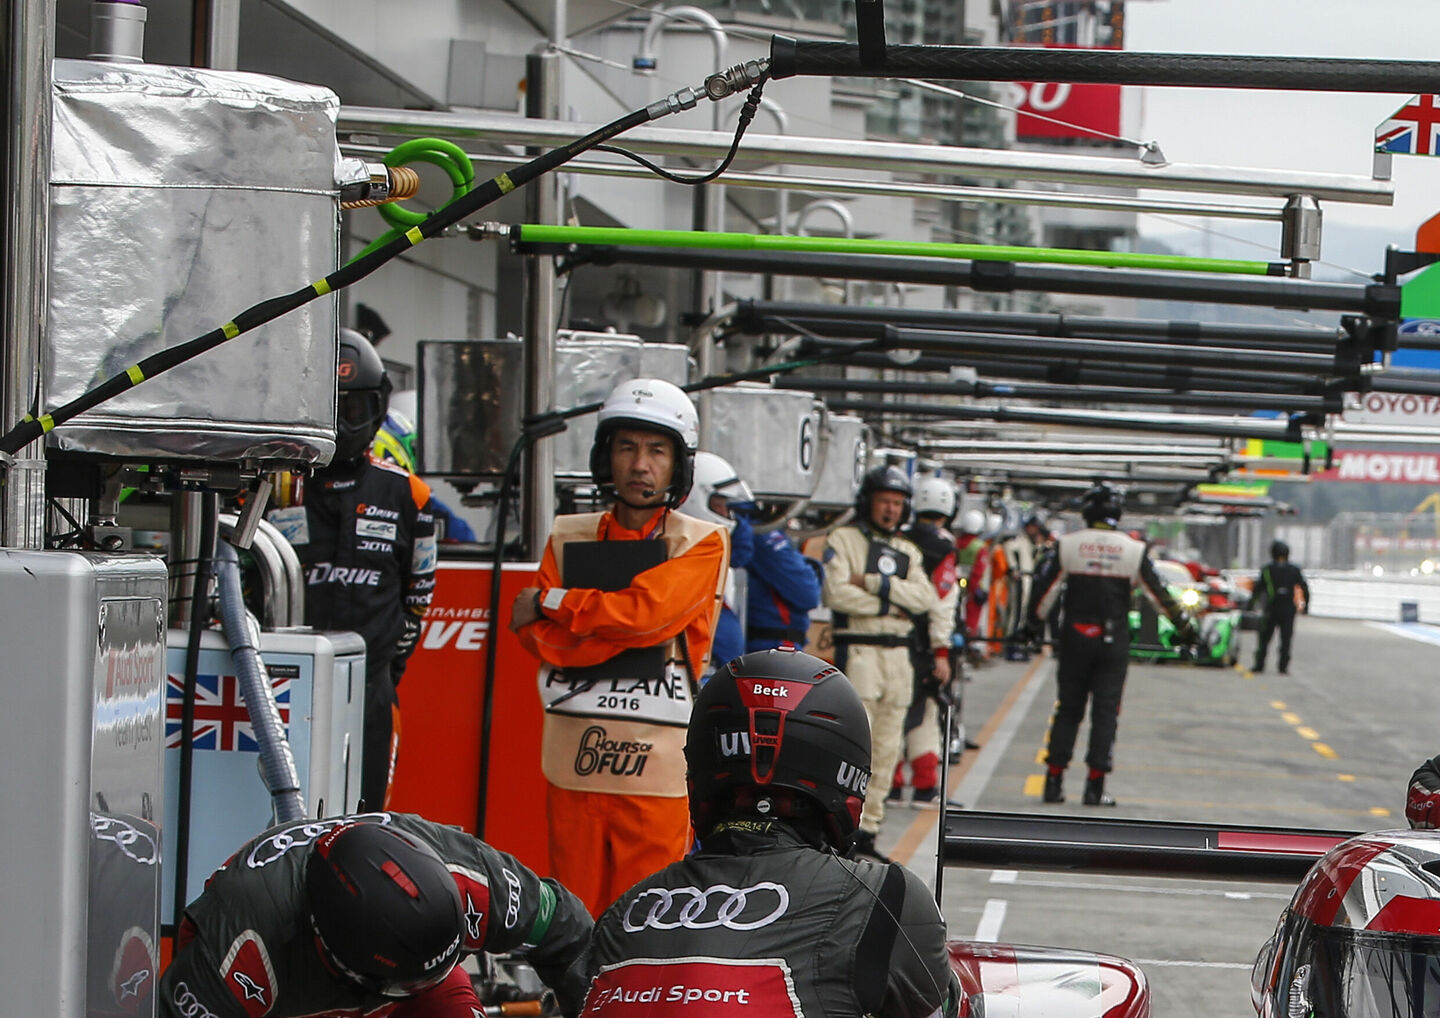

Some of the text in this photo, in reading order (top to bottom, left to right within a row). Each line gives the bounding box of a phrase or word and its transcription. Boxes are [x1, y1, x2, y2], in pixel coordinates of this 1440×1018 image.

[800, 417, 813, 471] 6
[753, 684, 789, 698] Beck
[597, 695, 641, 710] 2016
[595, 737, 641, 754] HOURS
[639, 743, 654, 752] OF
[597, 753, 649, 777] FUJI
[836, 761, 870, 796] uve
[608, 985, 750, 1005] Audi Sport
